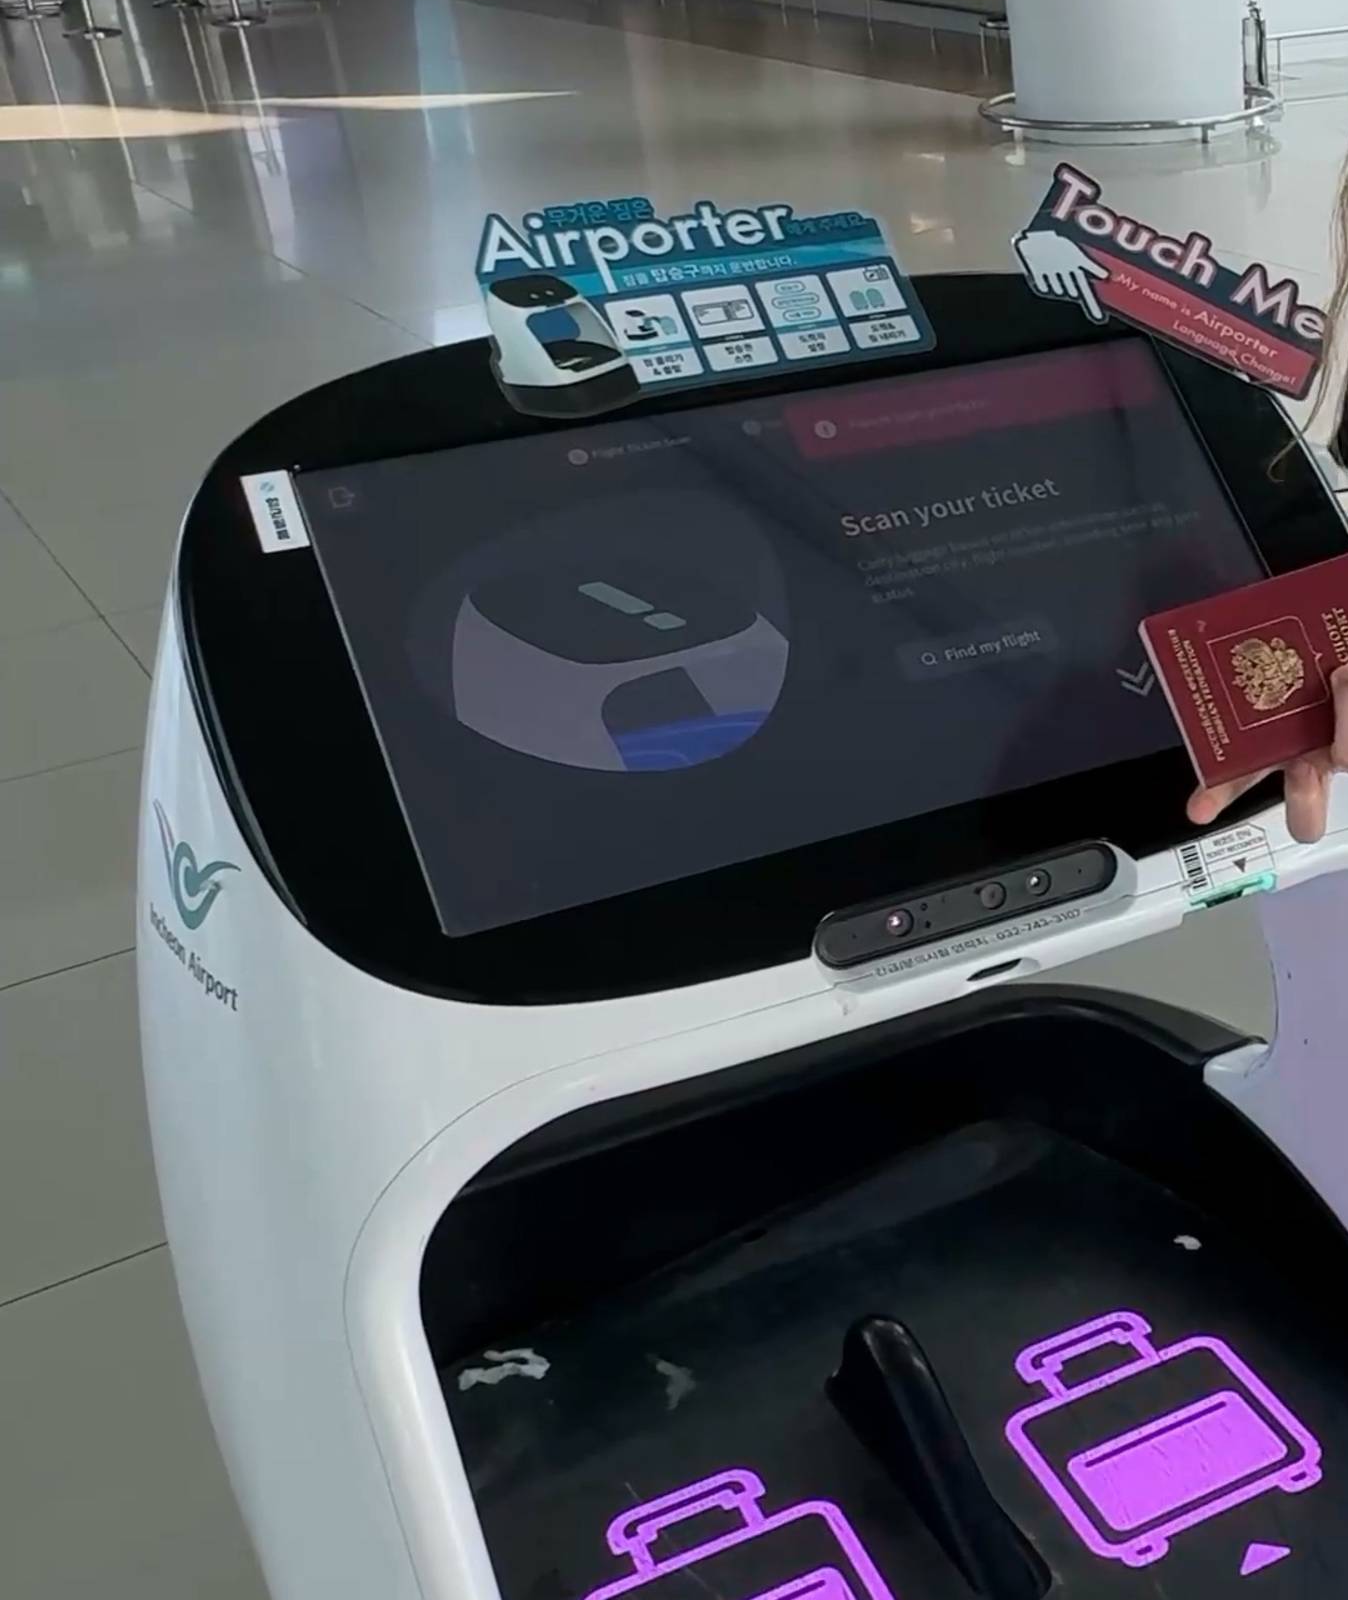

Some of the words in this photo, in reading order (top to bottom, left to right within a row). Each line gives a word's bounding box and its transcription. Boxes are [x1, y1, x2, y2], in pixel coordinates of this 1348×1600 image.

[481, 203, 788, 293] Airporter
[1052, 171, 1217, 287] Touch
[1231, 265, 1324, 340] Me
[1116, 272, 1140, 293] My
[1141, 287, 1179, 309] name
[1193, 309, 1280, 360] Airporter
[1171, 319, 1238, 360] Language
[841, 509, 911, 537] Scan
[913, 495, 977, 528] your
[981, 478, 1060, 509] ticket
[944, 646, 978, 662] Find
[979, 639, 1002, 655] my
[187, 951, 239, 1012] Airport
